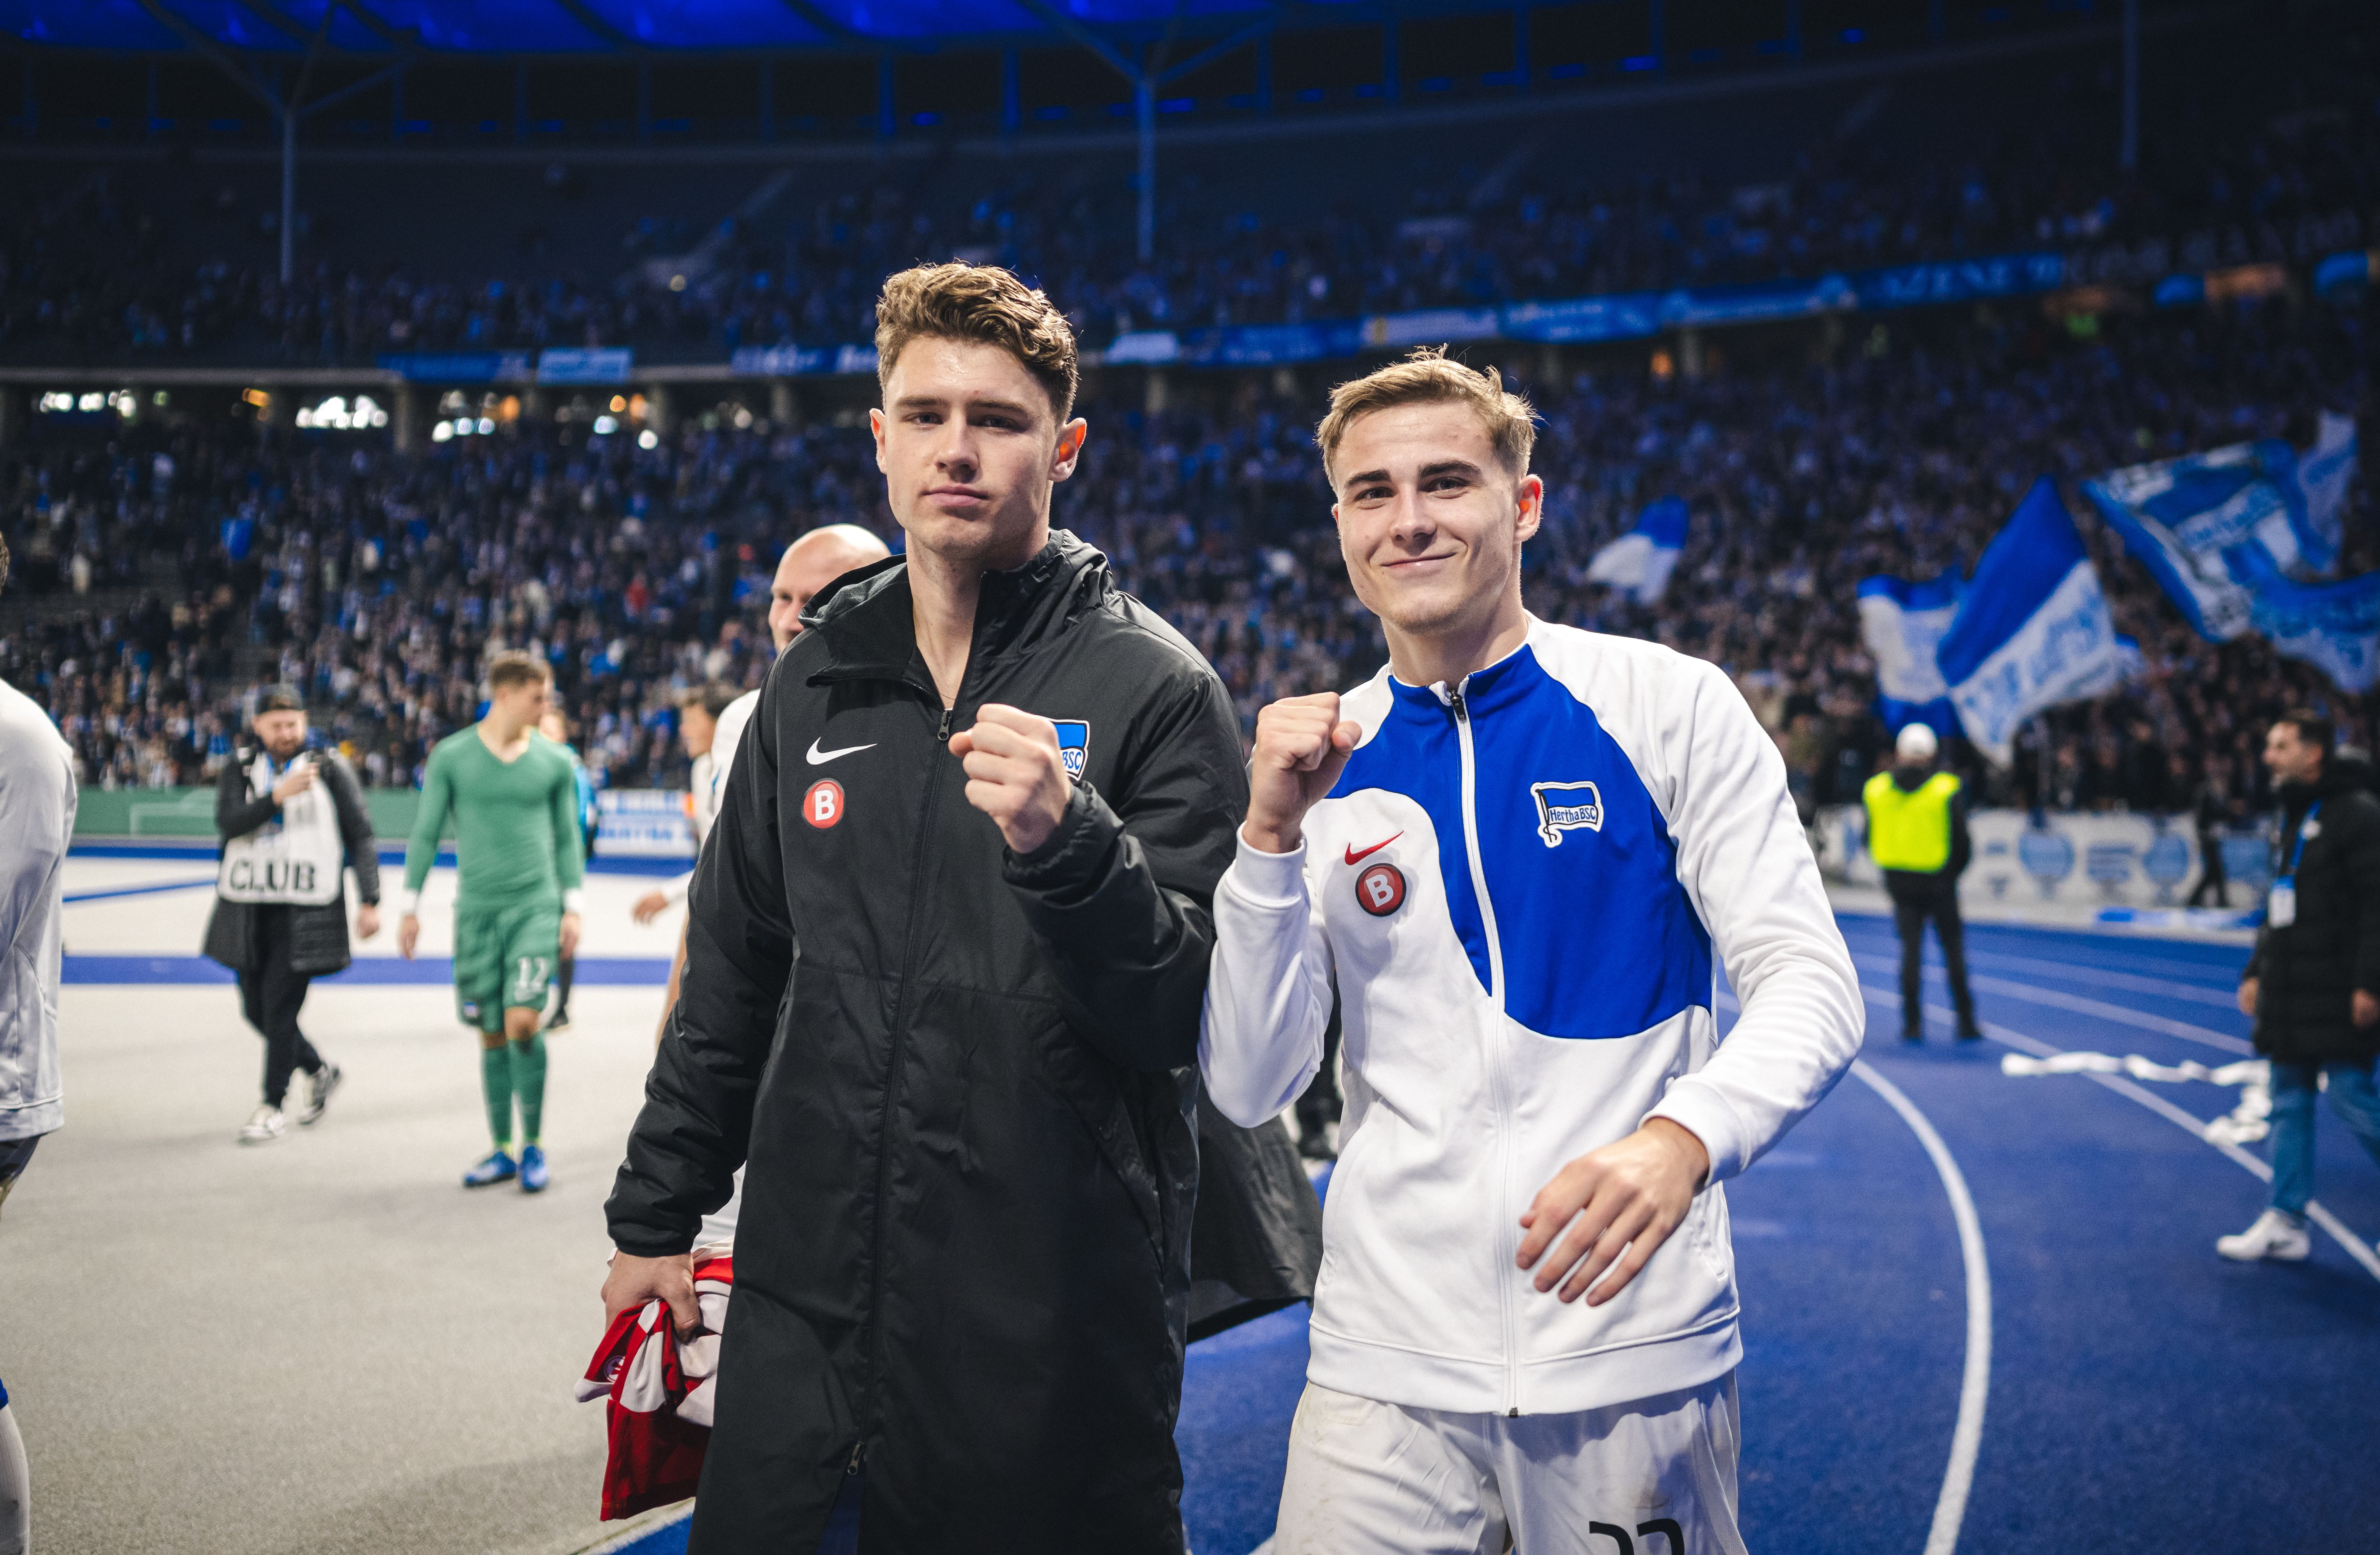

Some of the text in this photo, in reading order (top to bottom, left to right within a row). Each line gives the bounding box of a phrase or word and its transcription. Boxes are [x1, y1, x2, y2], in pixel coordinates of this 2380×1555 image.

[815, 790, 835, 821] B
[1549, 807, 1595, 822] Hertha BSC
[230, 859, 315, 892] CLUB
[1365, 874, 1394, 907] B
